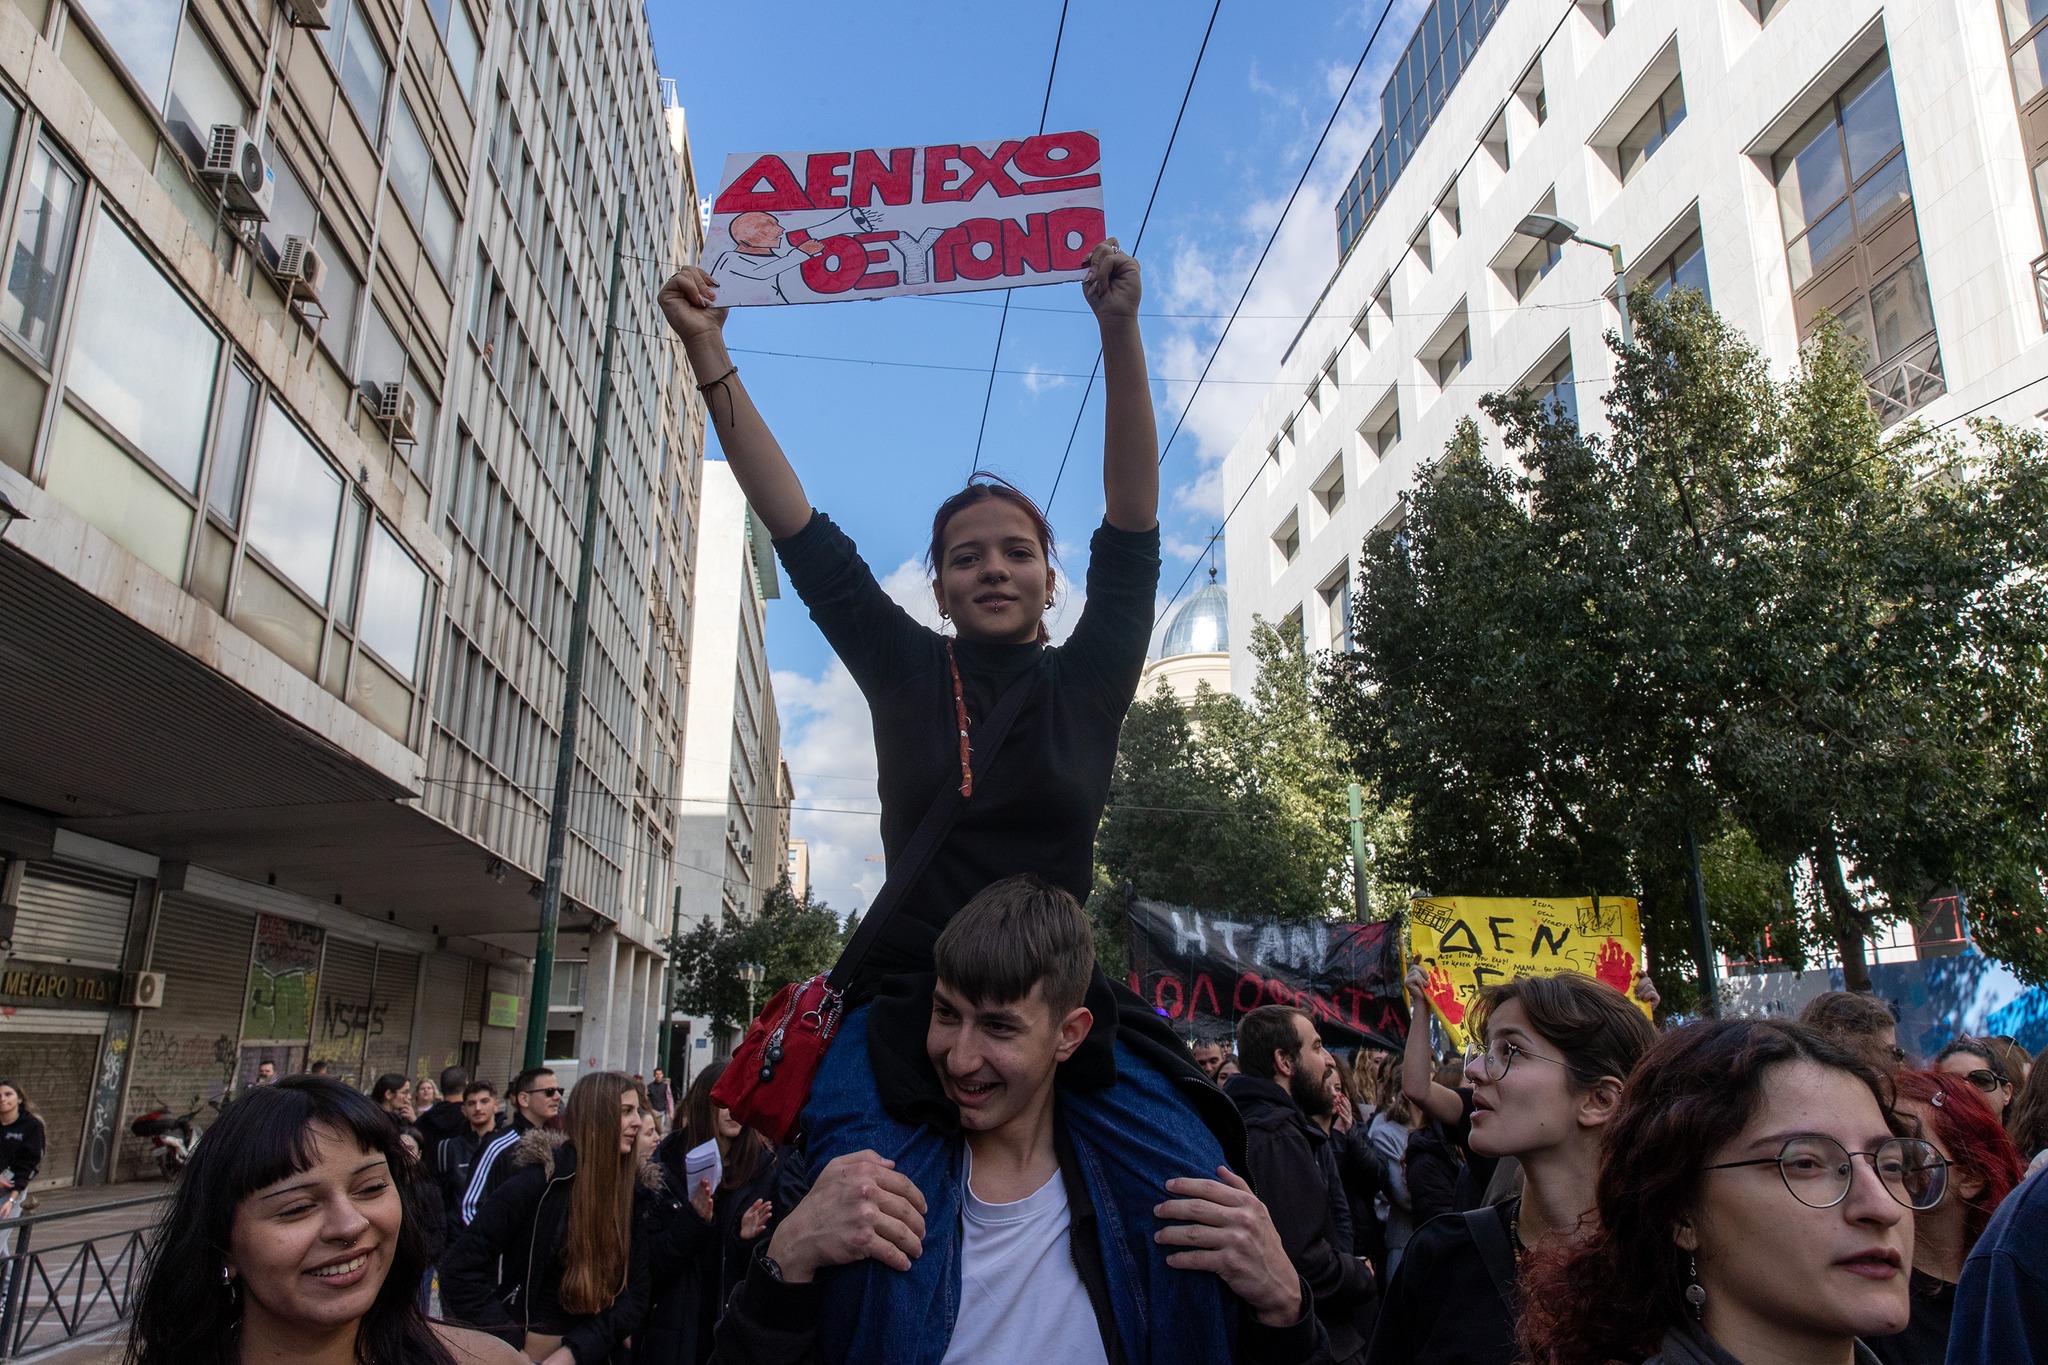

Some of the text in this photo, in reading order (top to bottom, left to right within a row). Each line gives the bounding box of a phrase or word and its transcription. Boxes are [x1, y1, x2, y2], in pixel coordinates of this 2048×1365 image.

[713, 148, 914, 213] ΔΕΝ
[1171, 911, 1329, 972] ΗΤΑΝ
[1439, 916, 1570, 957] ΔΕΝ
[1565, 949, 1597, 972] 57
[4, 971, 69, 999] ΜΕΓΑΡΟ
